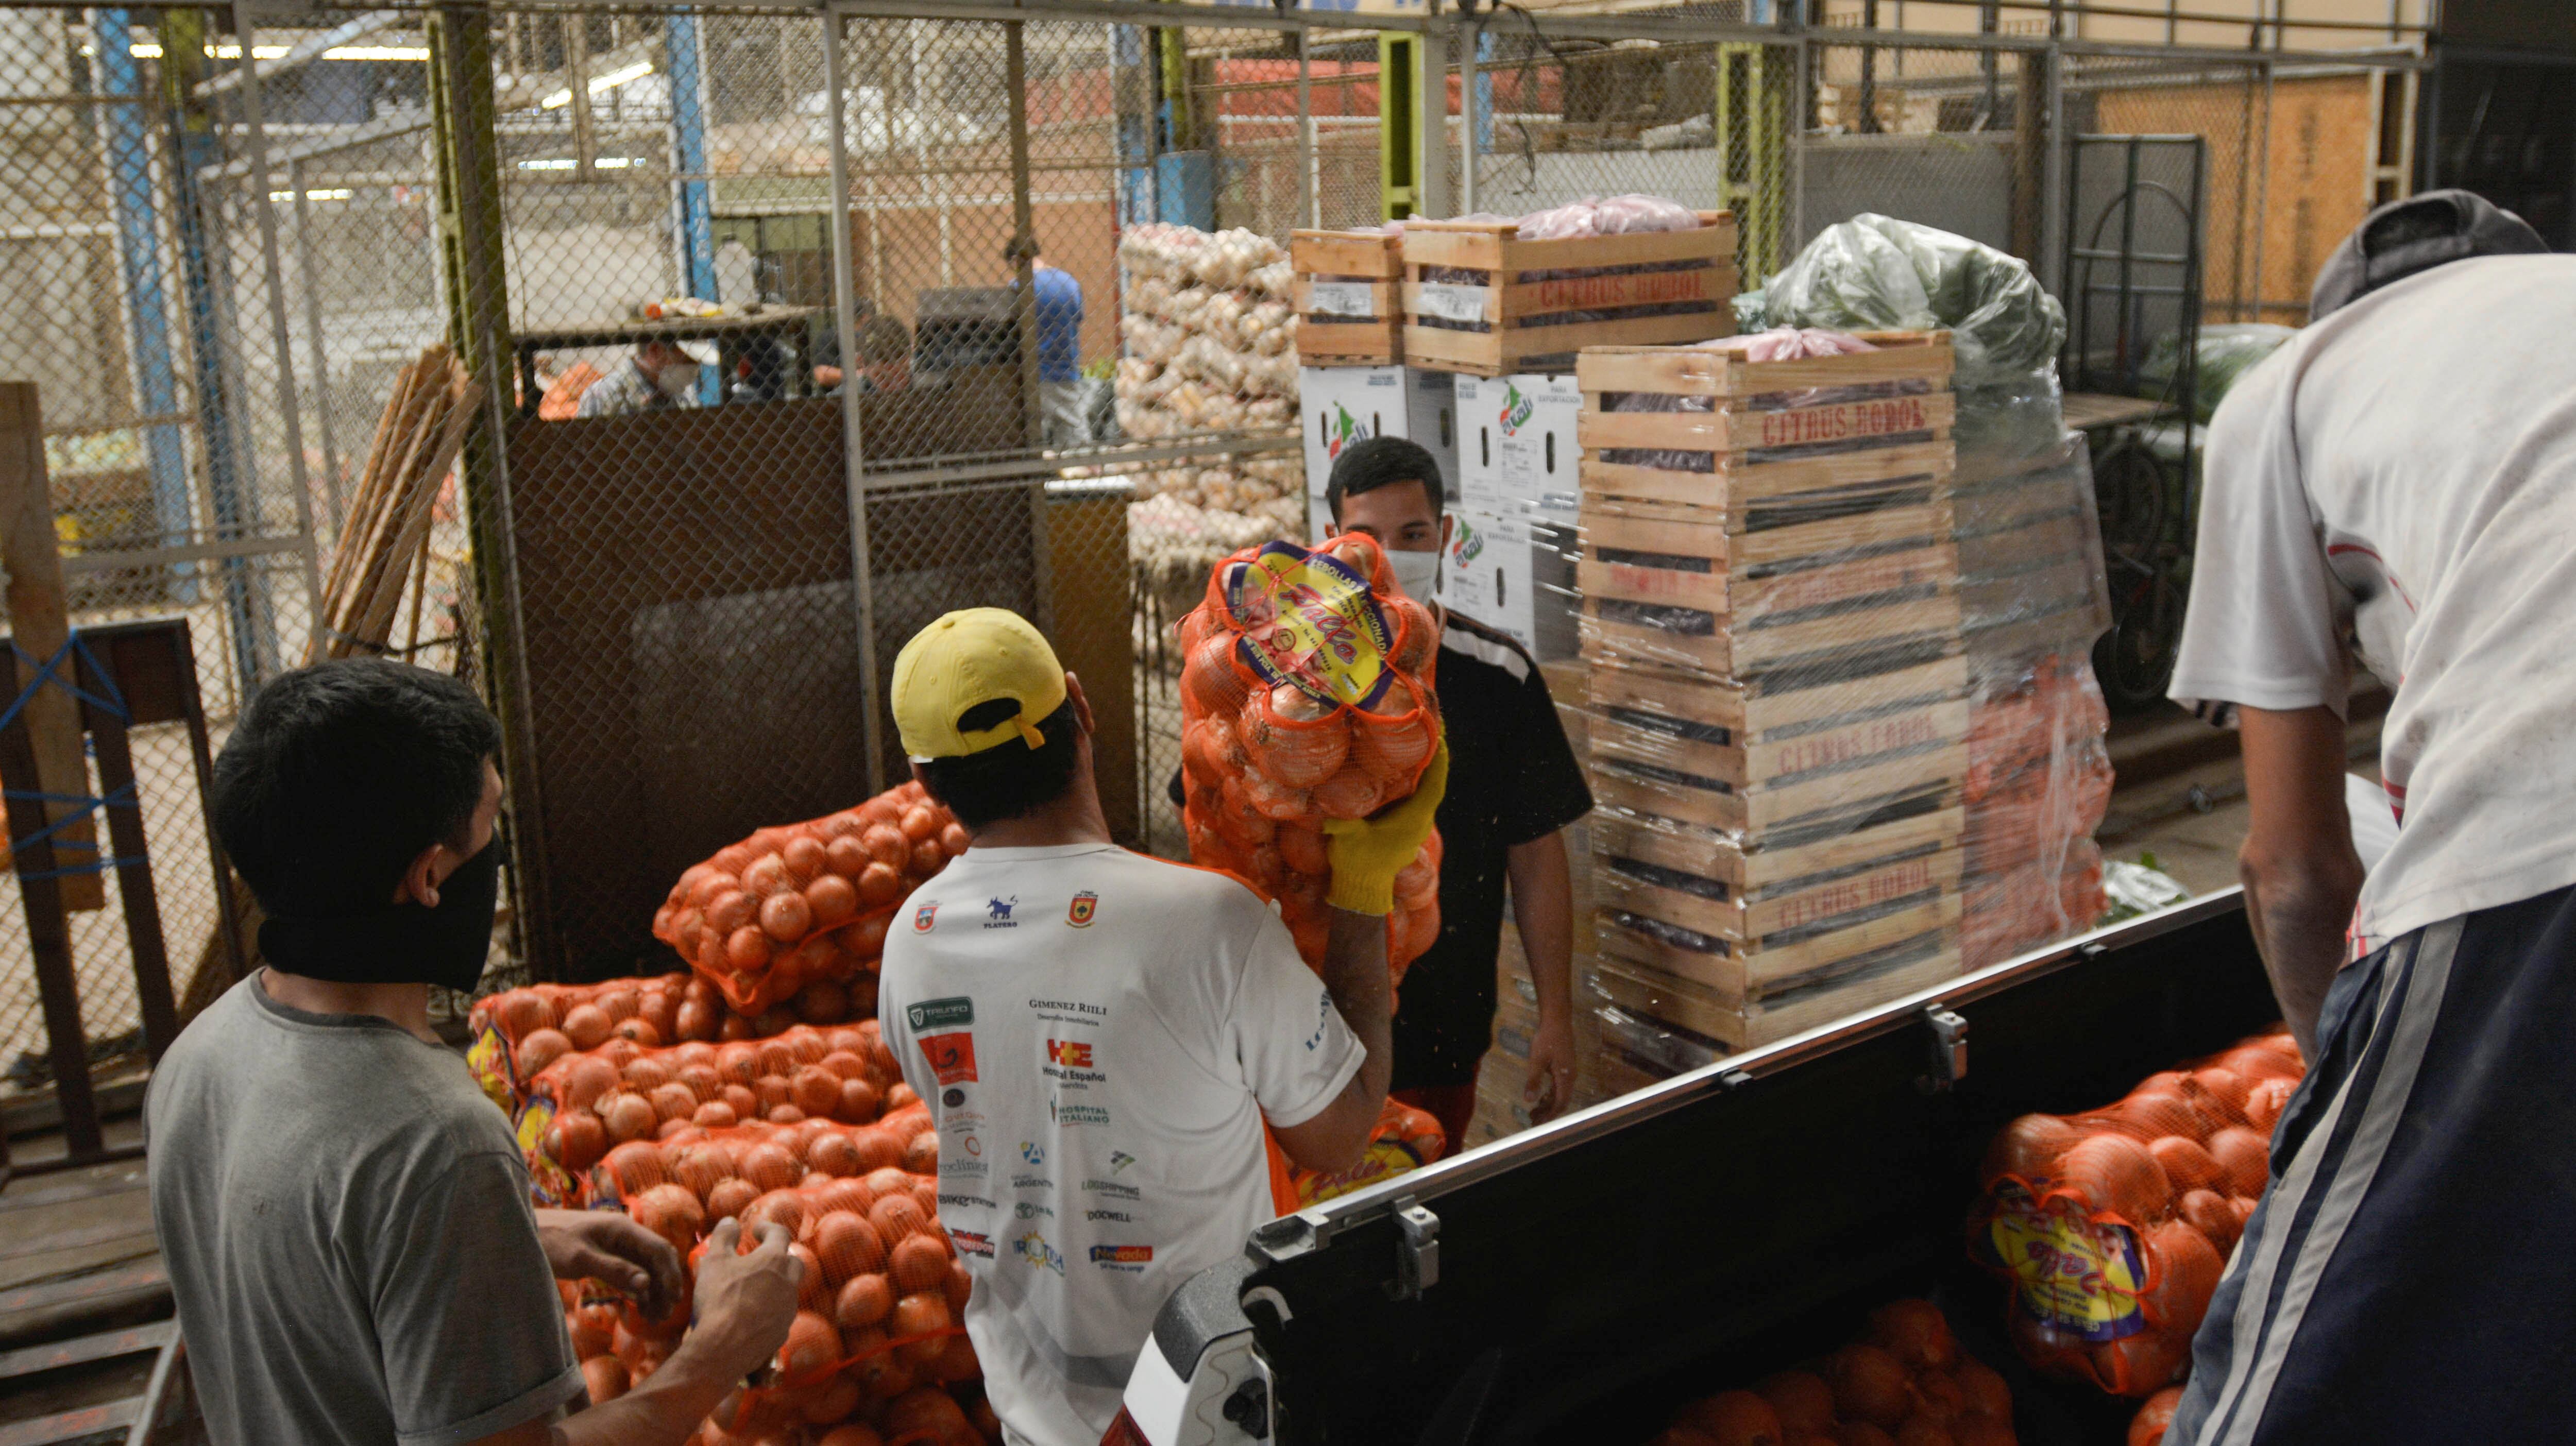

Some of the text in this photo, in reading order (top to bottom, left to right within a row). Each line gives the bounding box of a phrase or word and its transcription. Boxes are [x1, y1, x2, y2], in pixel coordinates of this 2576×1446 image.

[1762, 406, 1846, 447] CITRUS
[1029, 999, 1108, 1015] GIMENEZ RIILI
[1070, 1070, 1106, 1082] Español
[1058, 1106, 1108, 1115] HOSPITAL
[1059, 1115, 1109, 1124] ITALIANO
[1087, 1210, 1131, 1222] DOCWELL
